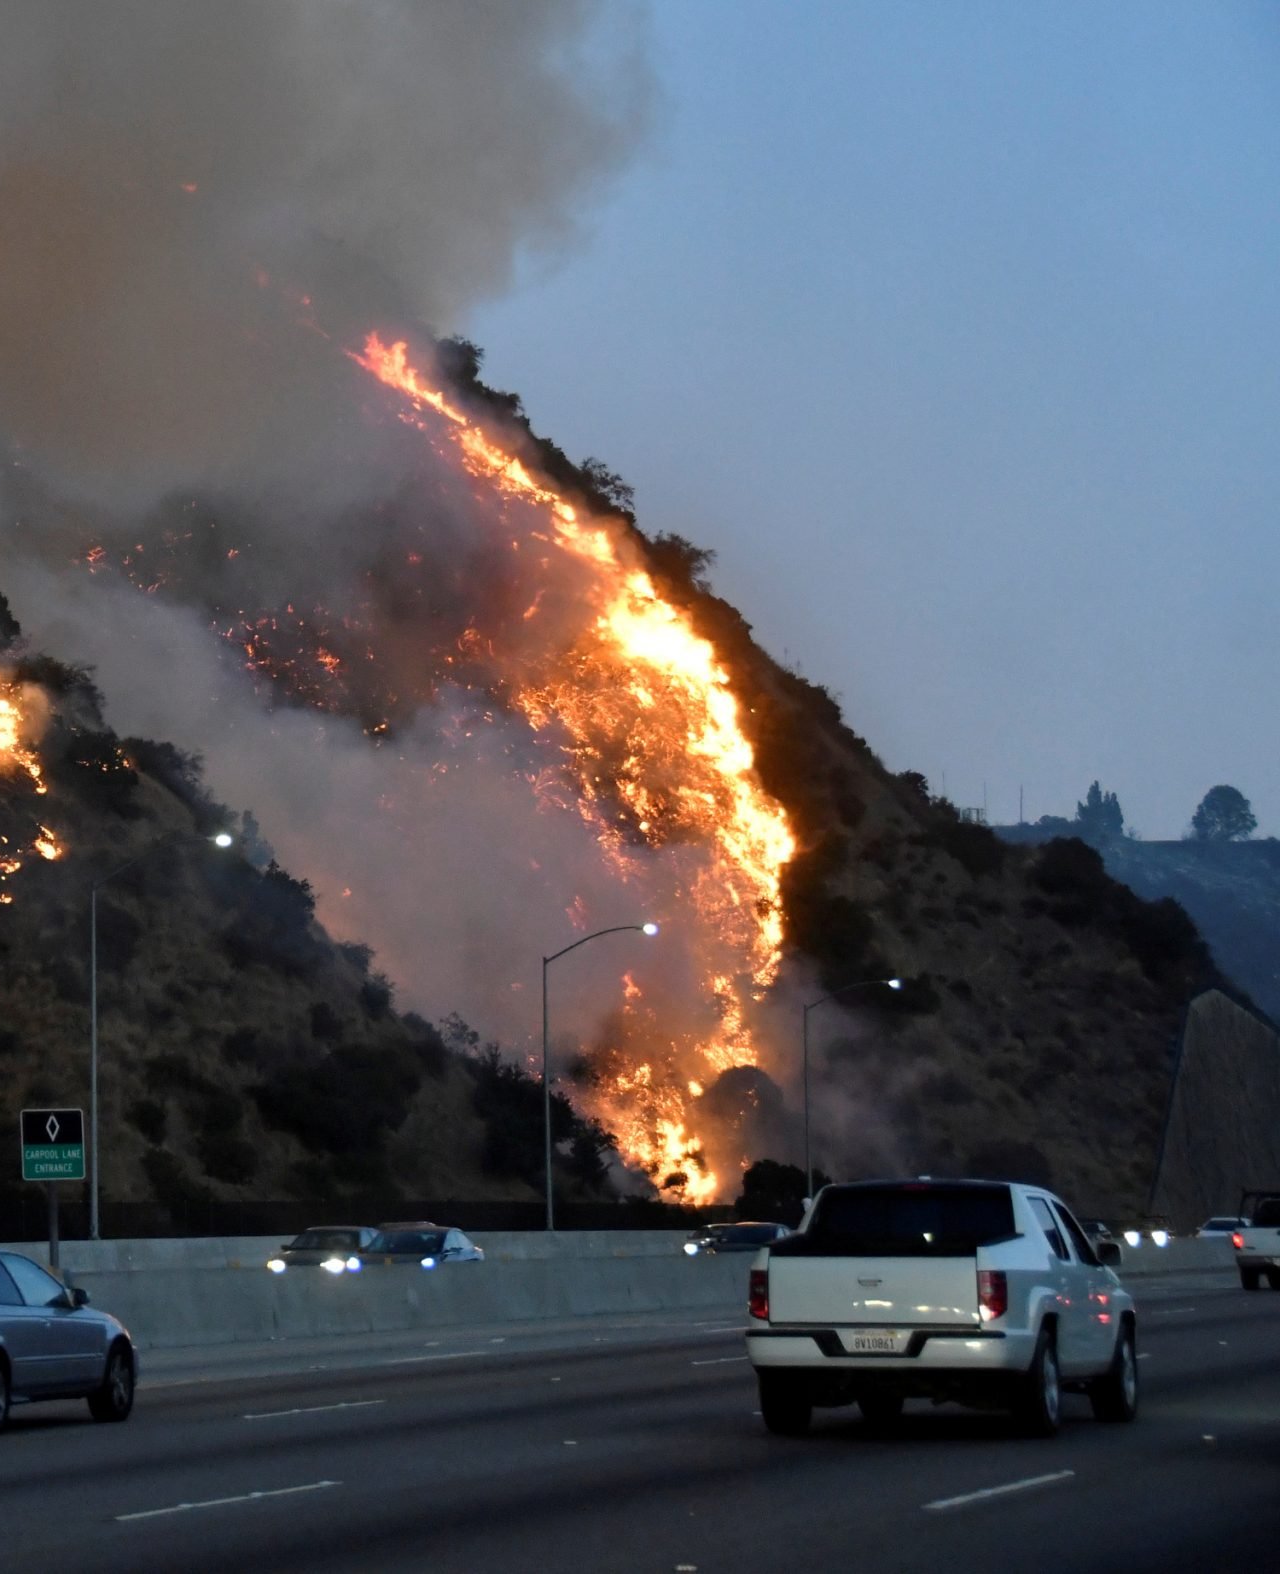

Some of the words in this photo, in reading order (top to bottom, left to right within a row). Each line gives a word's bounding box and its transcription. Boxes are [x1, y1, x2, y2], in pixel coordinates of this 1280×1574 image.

[25, 1150, 59, 1160] CARPOOL
[62, 1149, 81, 1159] LANE
[35, 1163, 73, 1173] ENTRANCE
